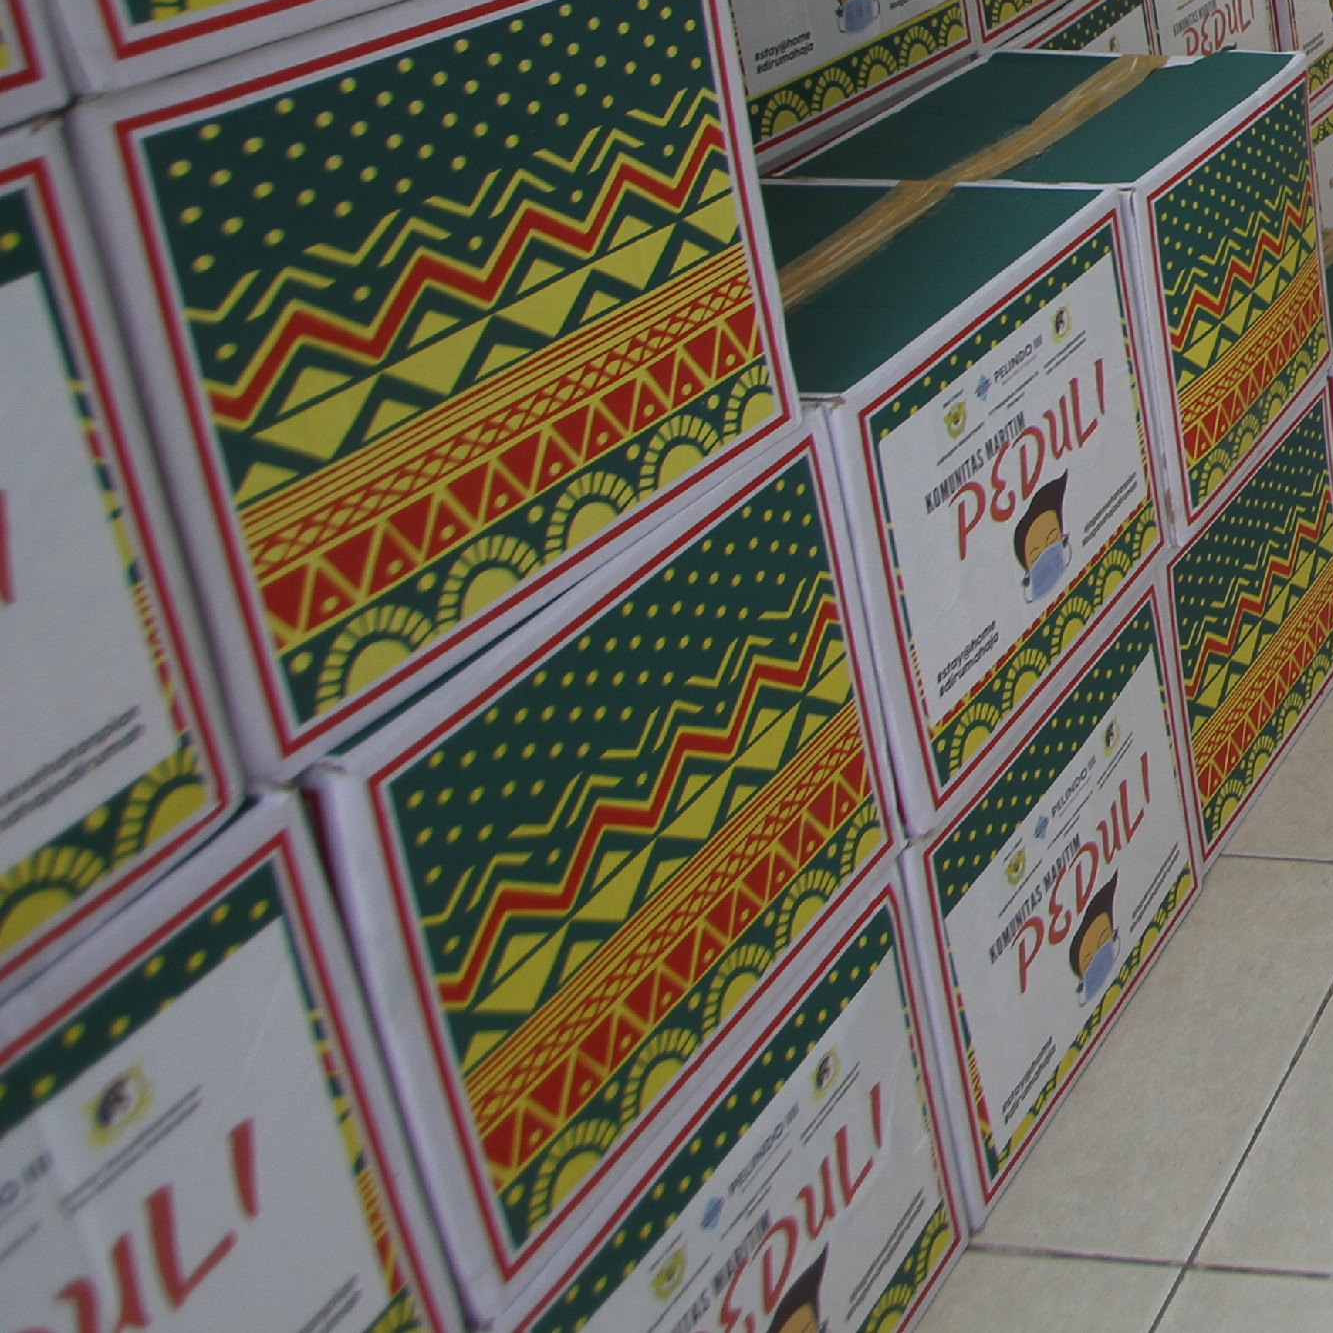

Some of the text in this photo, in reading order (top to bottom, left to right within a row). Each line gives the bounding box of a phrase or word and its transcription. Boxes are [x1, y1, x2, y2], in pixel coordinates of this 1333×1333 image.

[755, 31, 811, 62] #stay@home
[757, 42, 814, 74] #dirumahaja
[994, 343, 1033, 383] PELINDO
[924, 411, 1027, 515] KOMUNITAS MARITIM
[949, 358, 1105, 561] PEDULI
[1051, 768, 1089, 818] PELINDO
[988, 833, 1082, 965] KOMUNITAS MARITIM
[1011, 751, 1151, 994] PEDULI
[728, 1121, 785, 1197] PELINDO
[690, 1081, 882, 1333] EDULI
